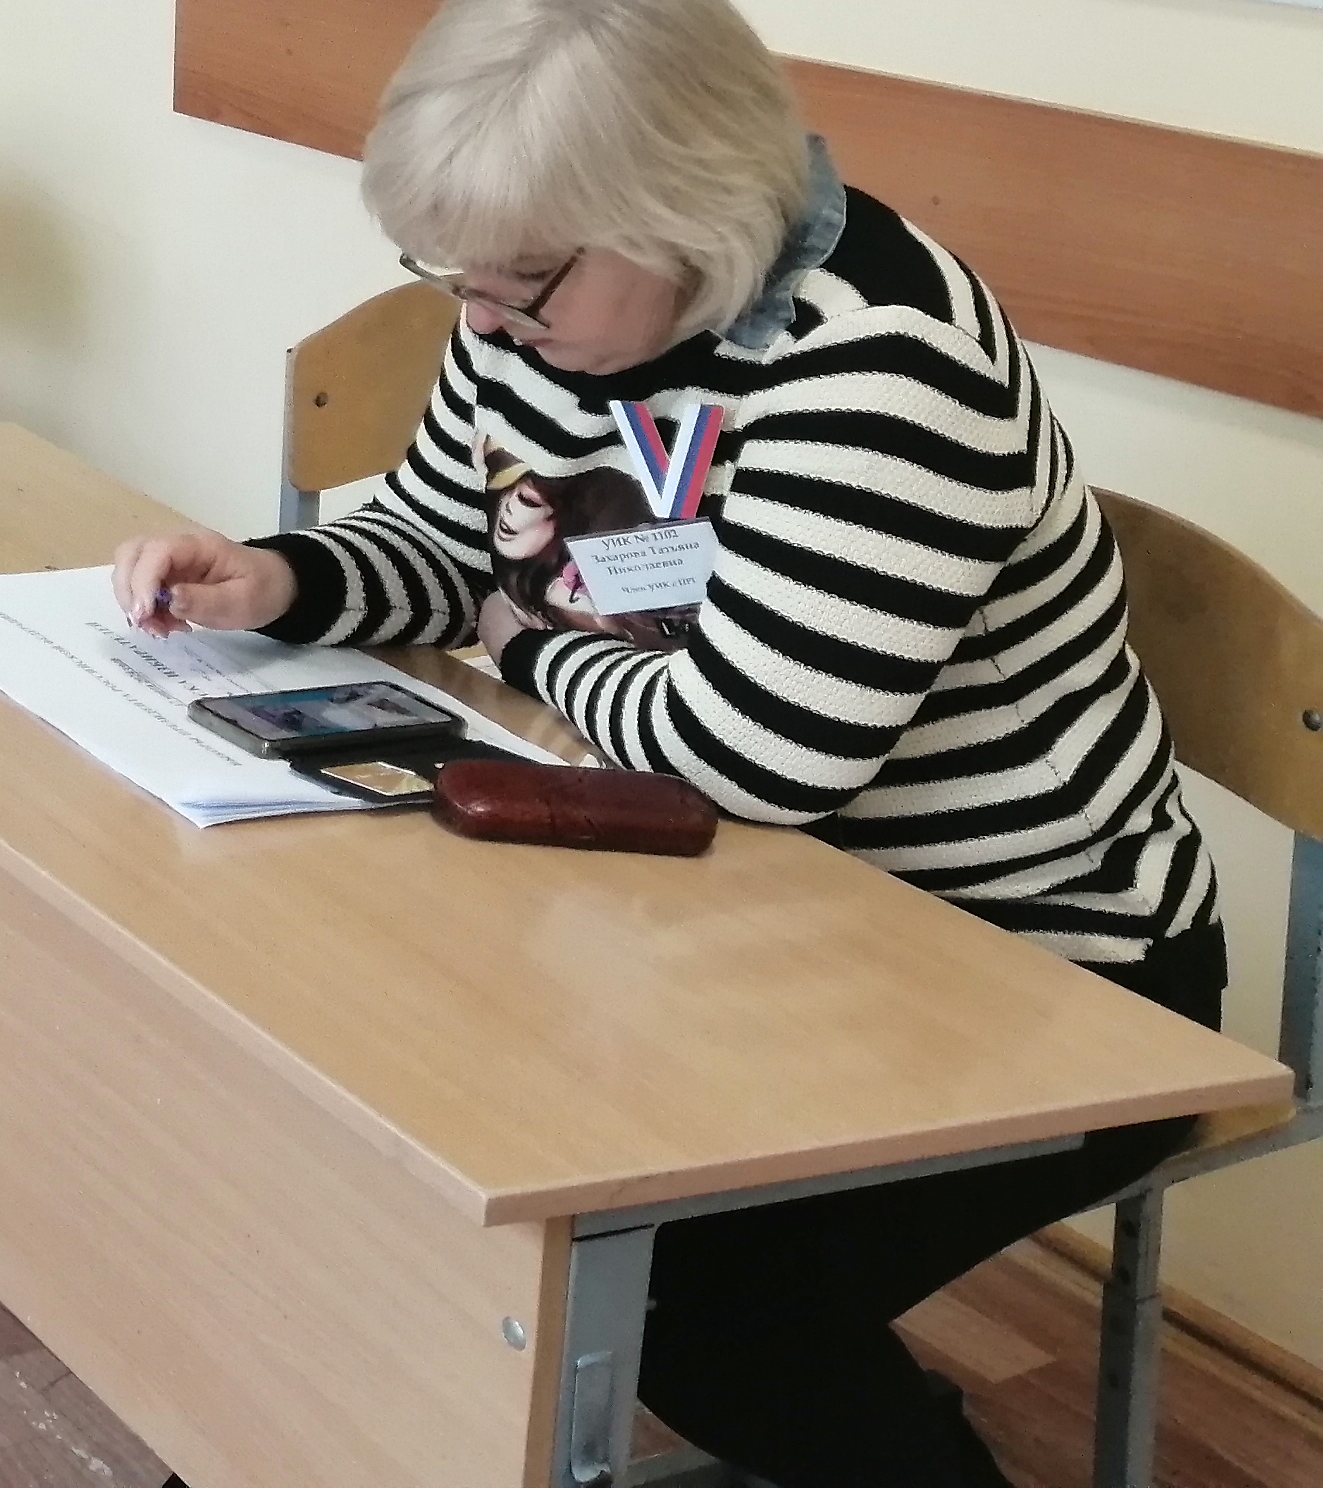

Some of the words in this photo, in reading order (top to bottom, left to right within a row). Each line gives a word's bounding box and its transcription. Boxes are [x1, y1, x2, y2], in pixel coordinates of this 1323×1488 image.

[601, 536, 632, 550] УИК
[635, 534, 650, 544] №
[591, 549, 647, 563] Захарова
[648, 541, 701, 555] Татьяна
[607, 558, 684, 576] Николаевна
